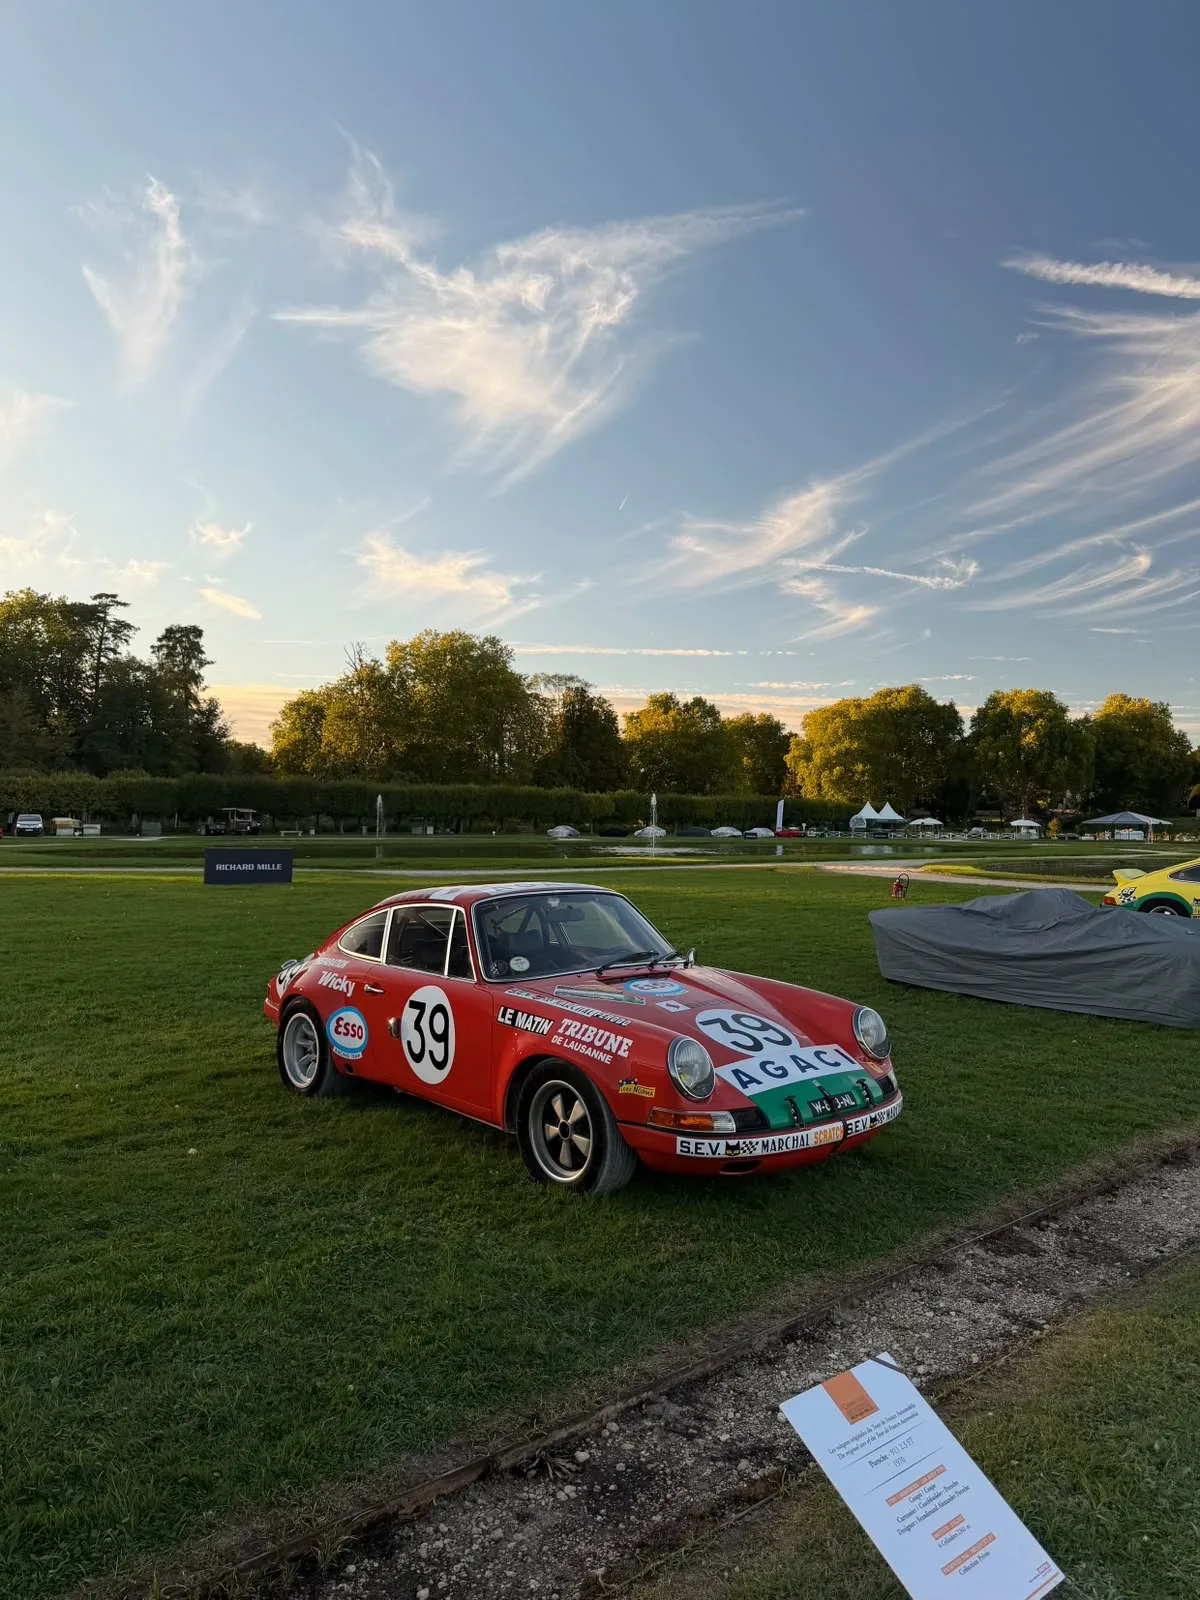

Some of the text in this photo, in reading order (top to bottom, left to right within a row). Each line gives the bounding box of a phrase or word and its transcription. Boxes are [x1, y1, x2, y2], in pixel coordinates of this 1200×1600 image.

[215, 863, 282, 871] RICHARD MILLE
[318, 971, 355, 997] Wicky
[334, 1016, 364, 1040] ESSO
[407, 999, 450, 1070] 39
[497, 1006, 553, 1035] LE MATIN
[698, 1013, 792, 1052] 39
[551, 1034, 613, 1065] DE LAUSANNE
[557, 1018, 634, 1058] TRIBUNE
[731, 1048, 857, 1090] AGACI
[679, 1140, 721, 1156] S.E.V.
[760, 1134, 810, 1153] MARCHAL
[814, 1126, 844, 1145] SCRATCH
[868, 1453, 889, 1468] Porsche
